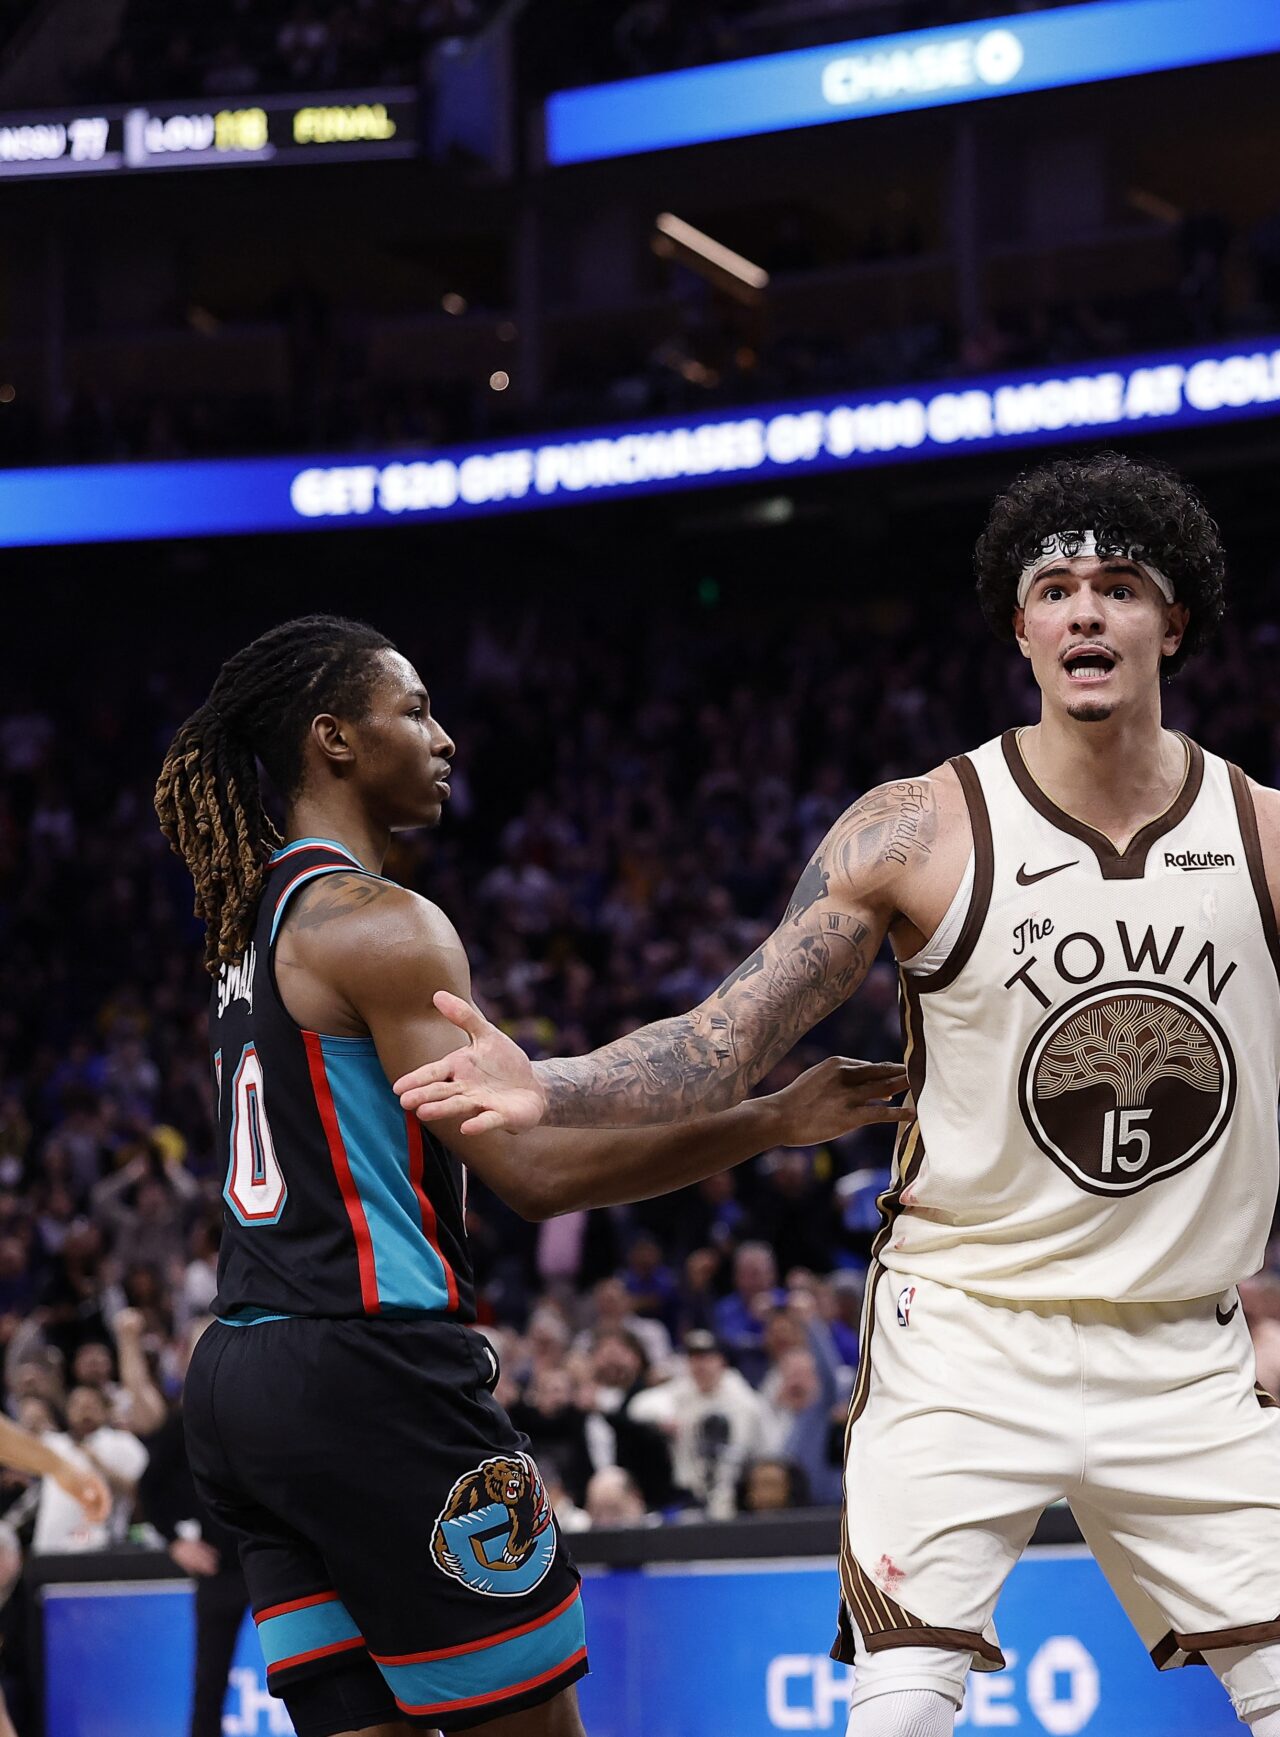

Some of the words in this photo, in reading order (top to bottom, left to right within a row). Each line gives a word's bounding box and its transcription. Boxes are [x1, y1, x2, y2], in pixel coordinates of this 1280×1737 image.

[821, 37, 974, 105] CHASE
[145, 113, 214, 153] LOU
[293, 103, 396, 144] FINAL
[290, 465, 378, 517] GET
[379, 460, 459, 514] $20
[459, 449, 534, 504] OFF
[535, 418, 766, 495] PURCHASES
[766, 410, 826, 464] OF
[824, 398, 927, 460] $100
[927, 389, 995, 443] OR
[994, 372, 1125, 436] MORE
[1125, 364, 1186, 419] AT
[1164, 850, 1235, 870] Rakuten
[1005, 920, 1237, 1009] TOWN
[1012, 916, 1054, 955] The
[1101, 1108, 1153, 1174] 15
[767, 1652, 1020, 1730] CHE
